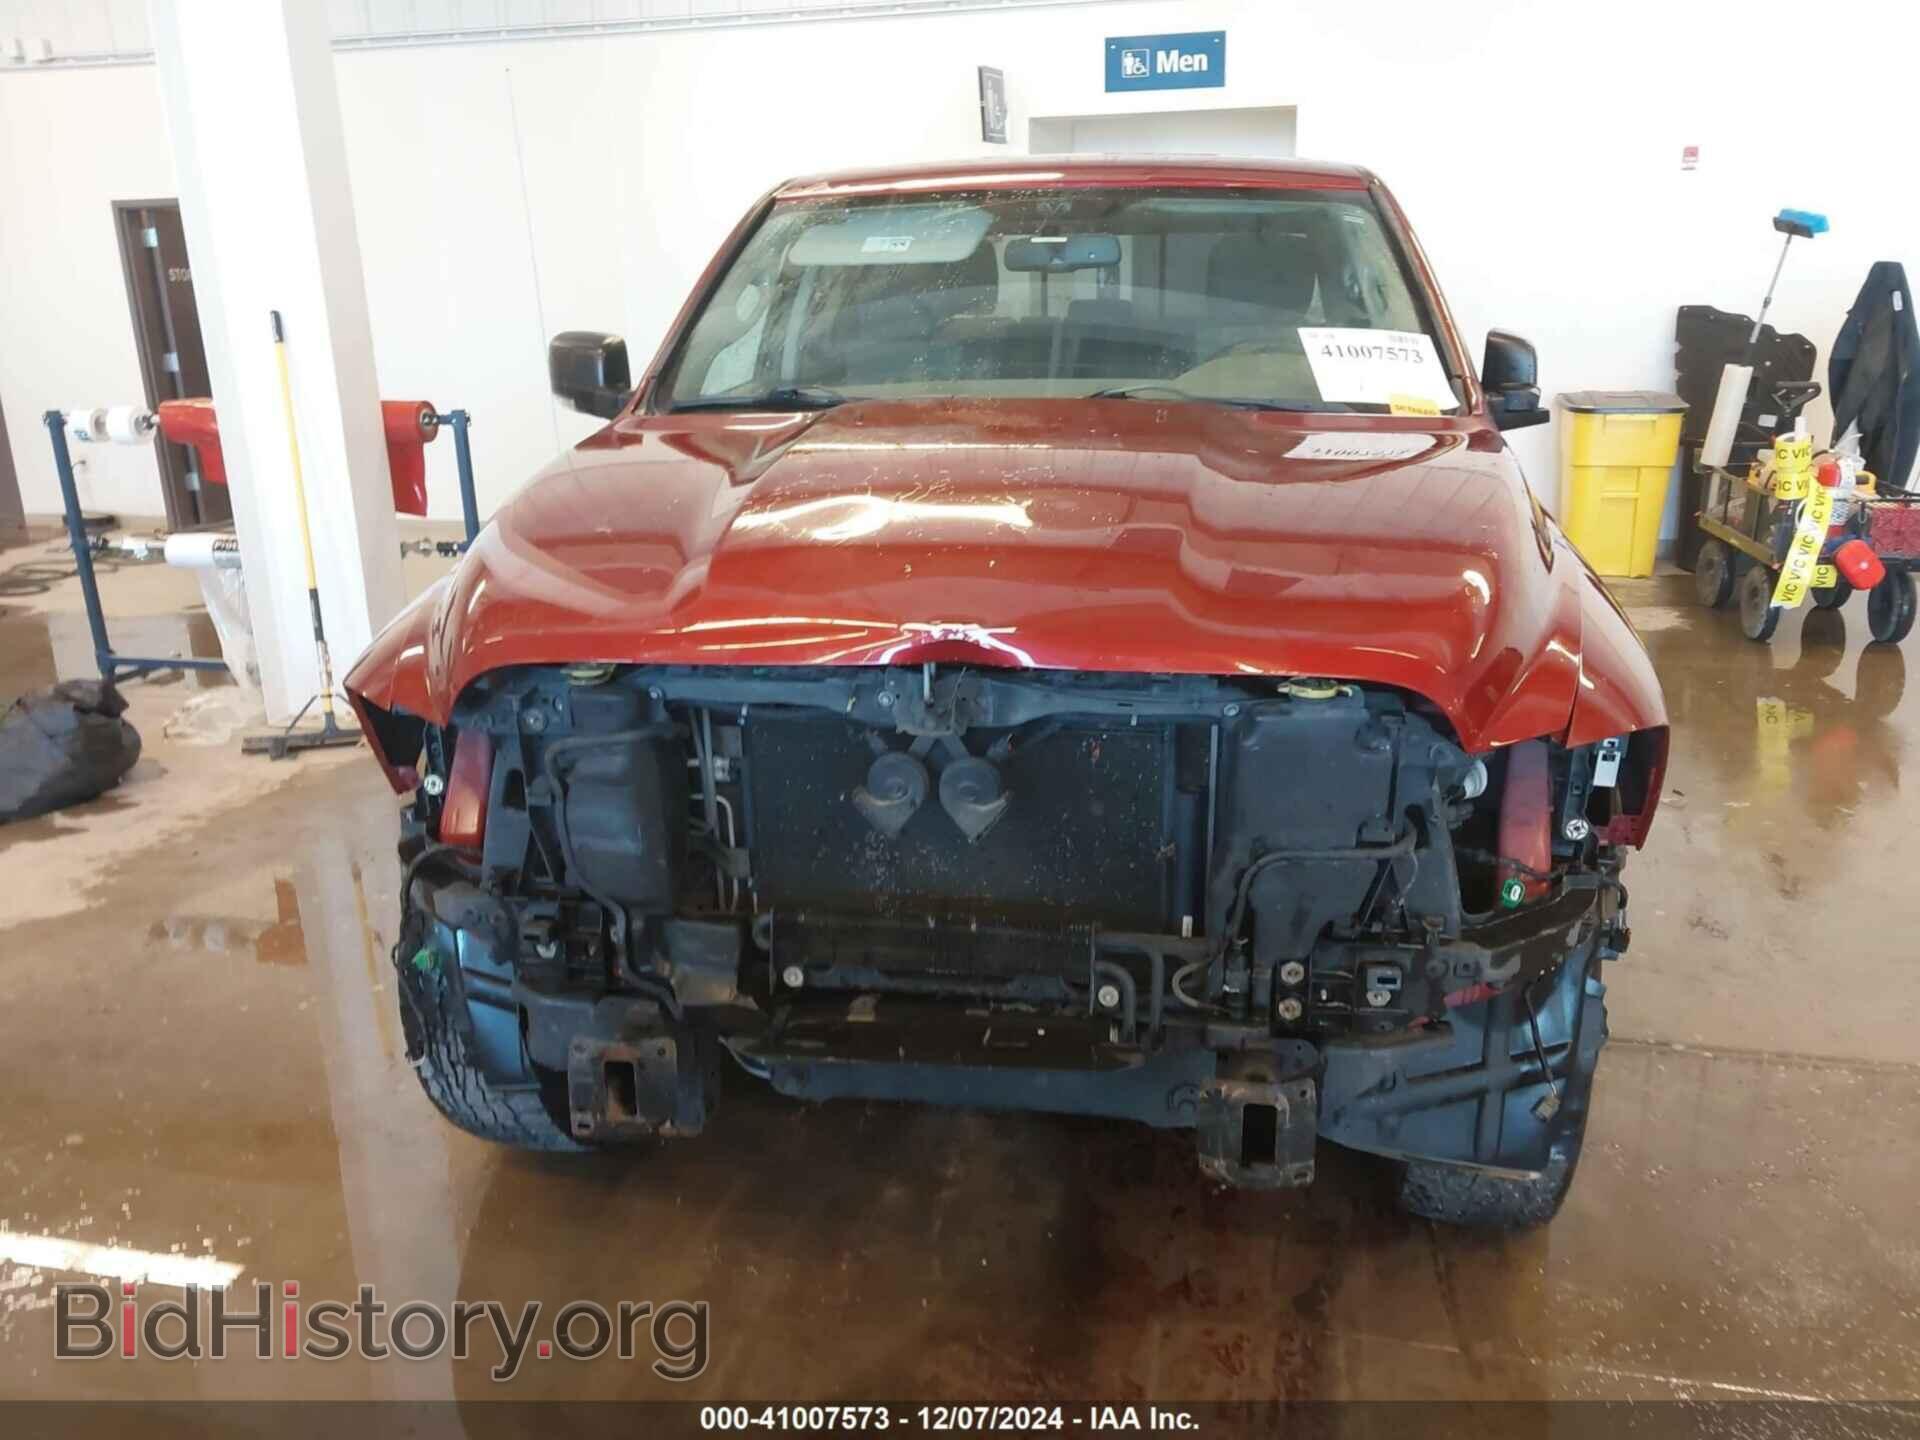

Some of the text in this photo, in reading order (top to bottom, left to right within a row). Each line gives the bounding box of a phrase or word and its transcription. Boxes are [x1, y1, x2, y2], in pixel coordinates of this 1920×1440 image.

[1156, 49, 1208, 73] Men
[1321, 345, 1424, 364] 41007573
[1799, 535, 1815, 556] VIC
[1789, 559, 1806, 580] VIC
[1815, 566, 1829, 586] VIC
[1781, 583, 1798, 602] VIC
